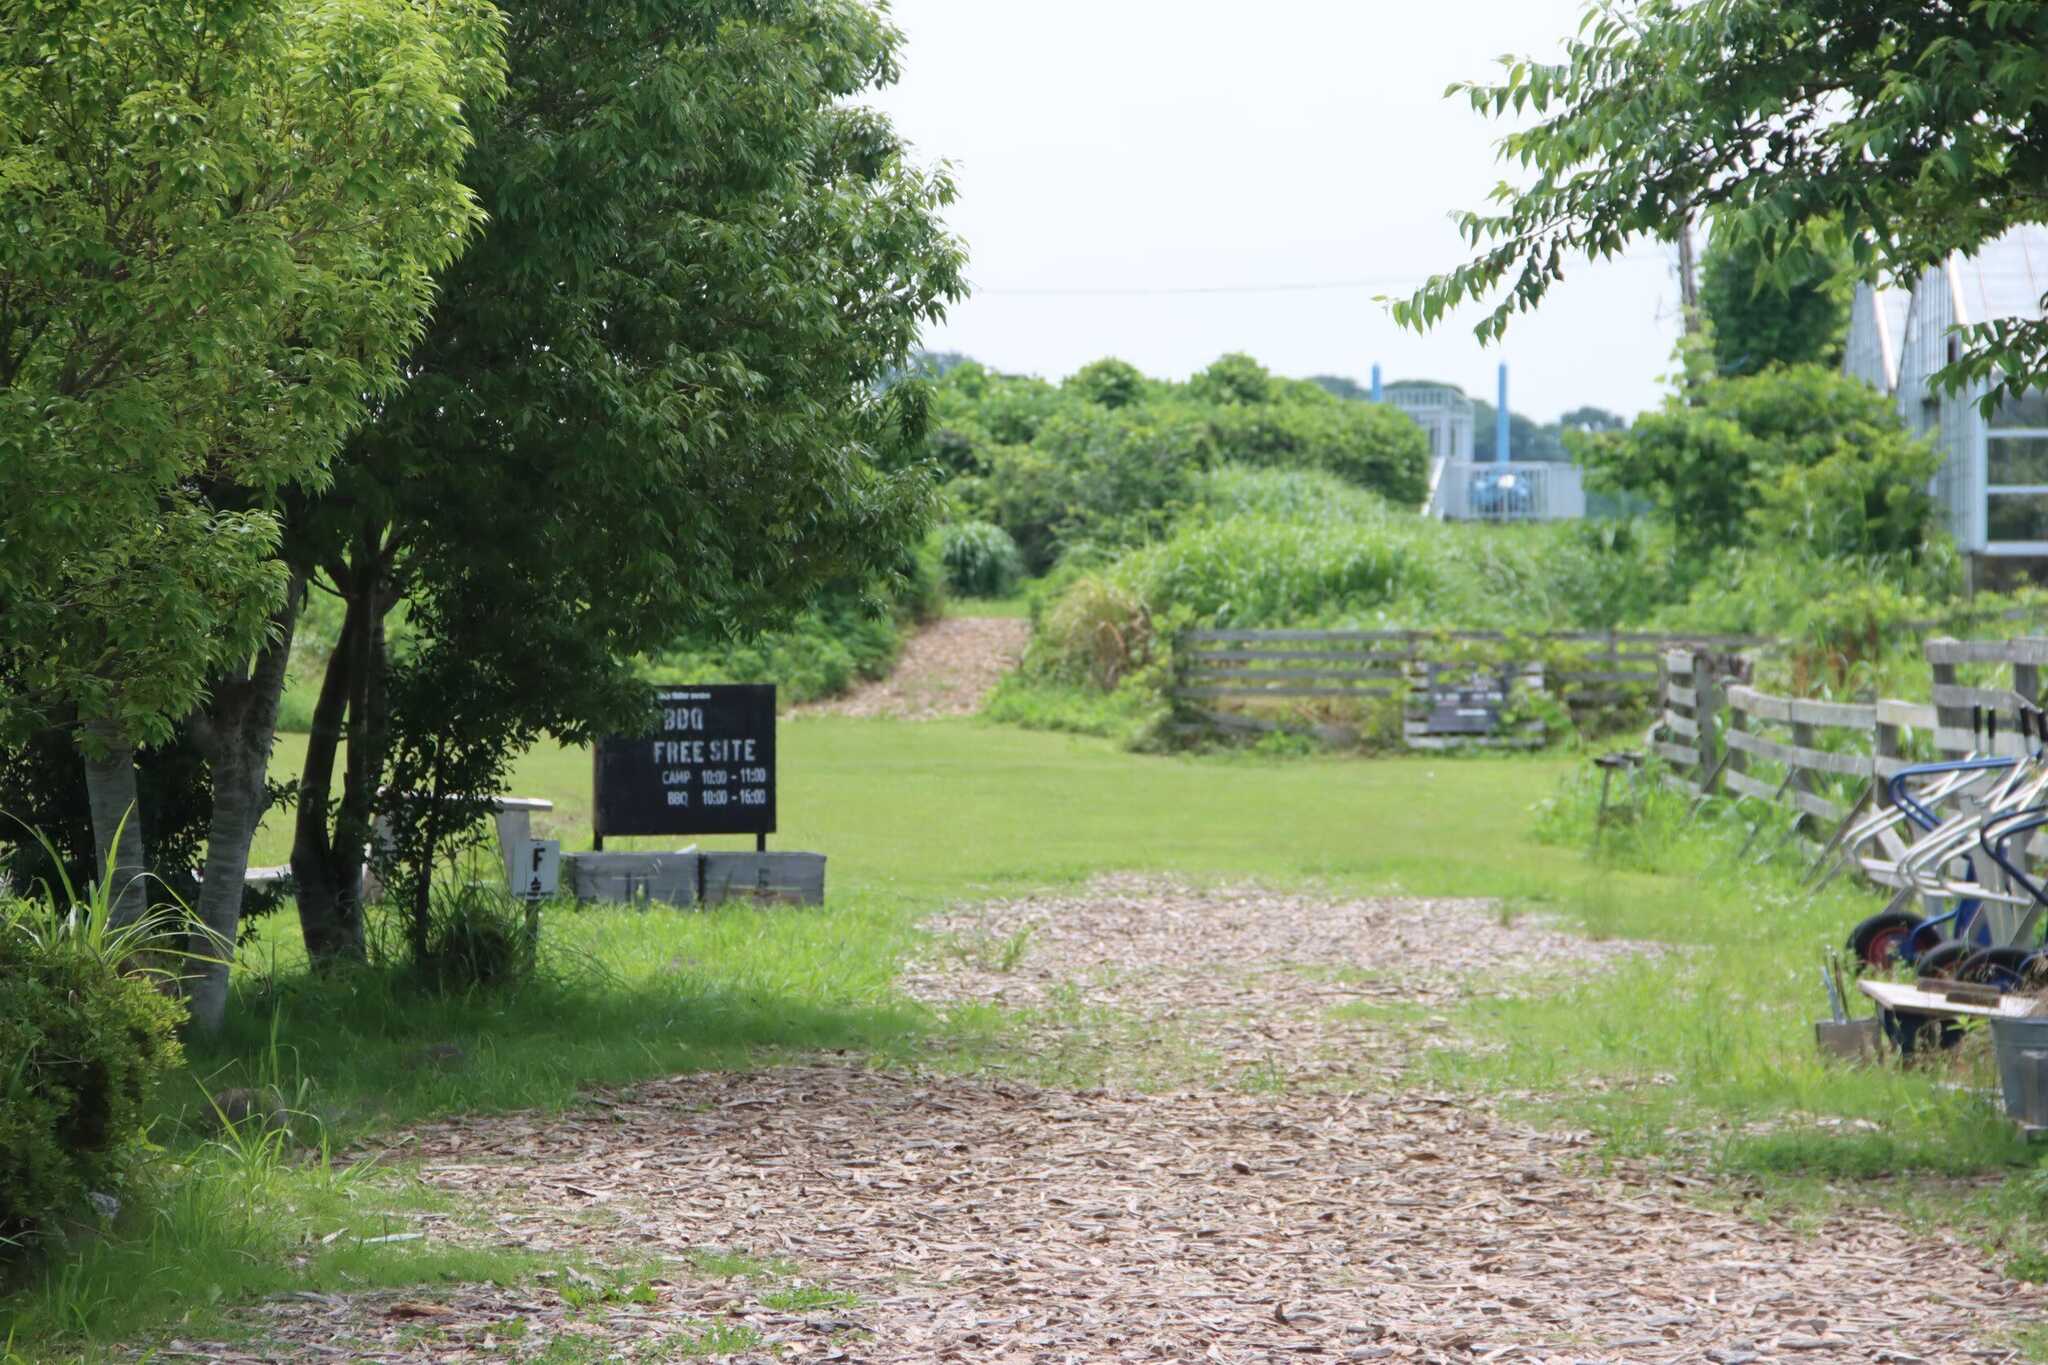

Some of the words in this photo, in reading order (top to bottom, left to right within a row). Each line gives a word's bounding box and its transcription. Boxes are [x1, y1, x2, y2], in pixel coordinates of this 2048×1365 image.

[654, 740, 704, 763] FREE
[710, 739, 756, 762] SITE
[663, 770, 689, 785] CAMP
[702, 770, 727, 785] 10:00
[740, 768, 766, 783] 11:00
[667, 791, 688, 807] BBQ
[702, 790, 727, 805] 10:00
[533, 848, 546, 872] F
